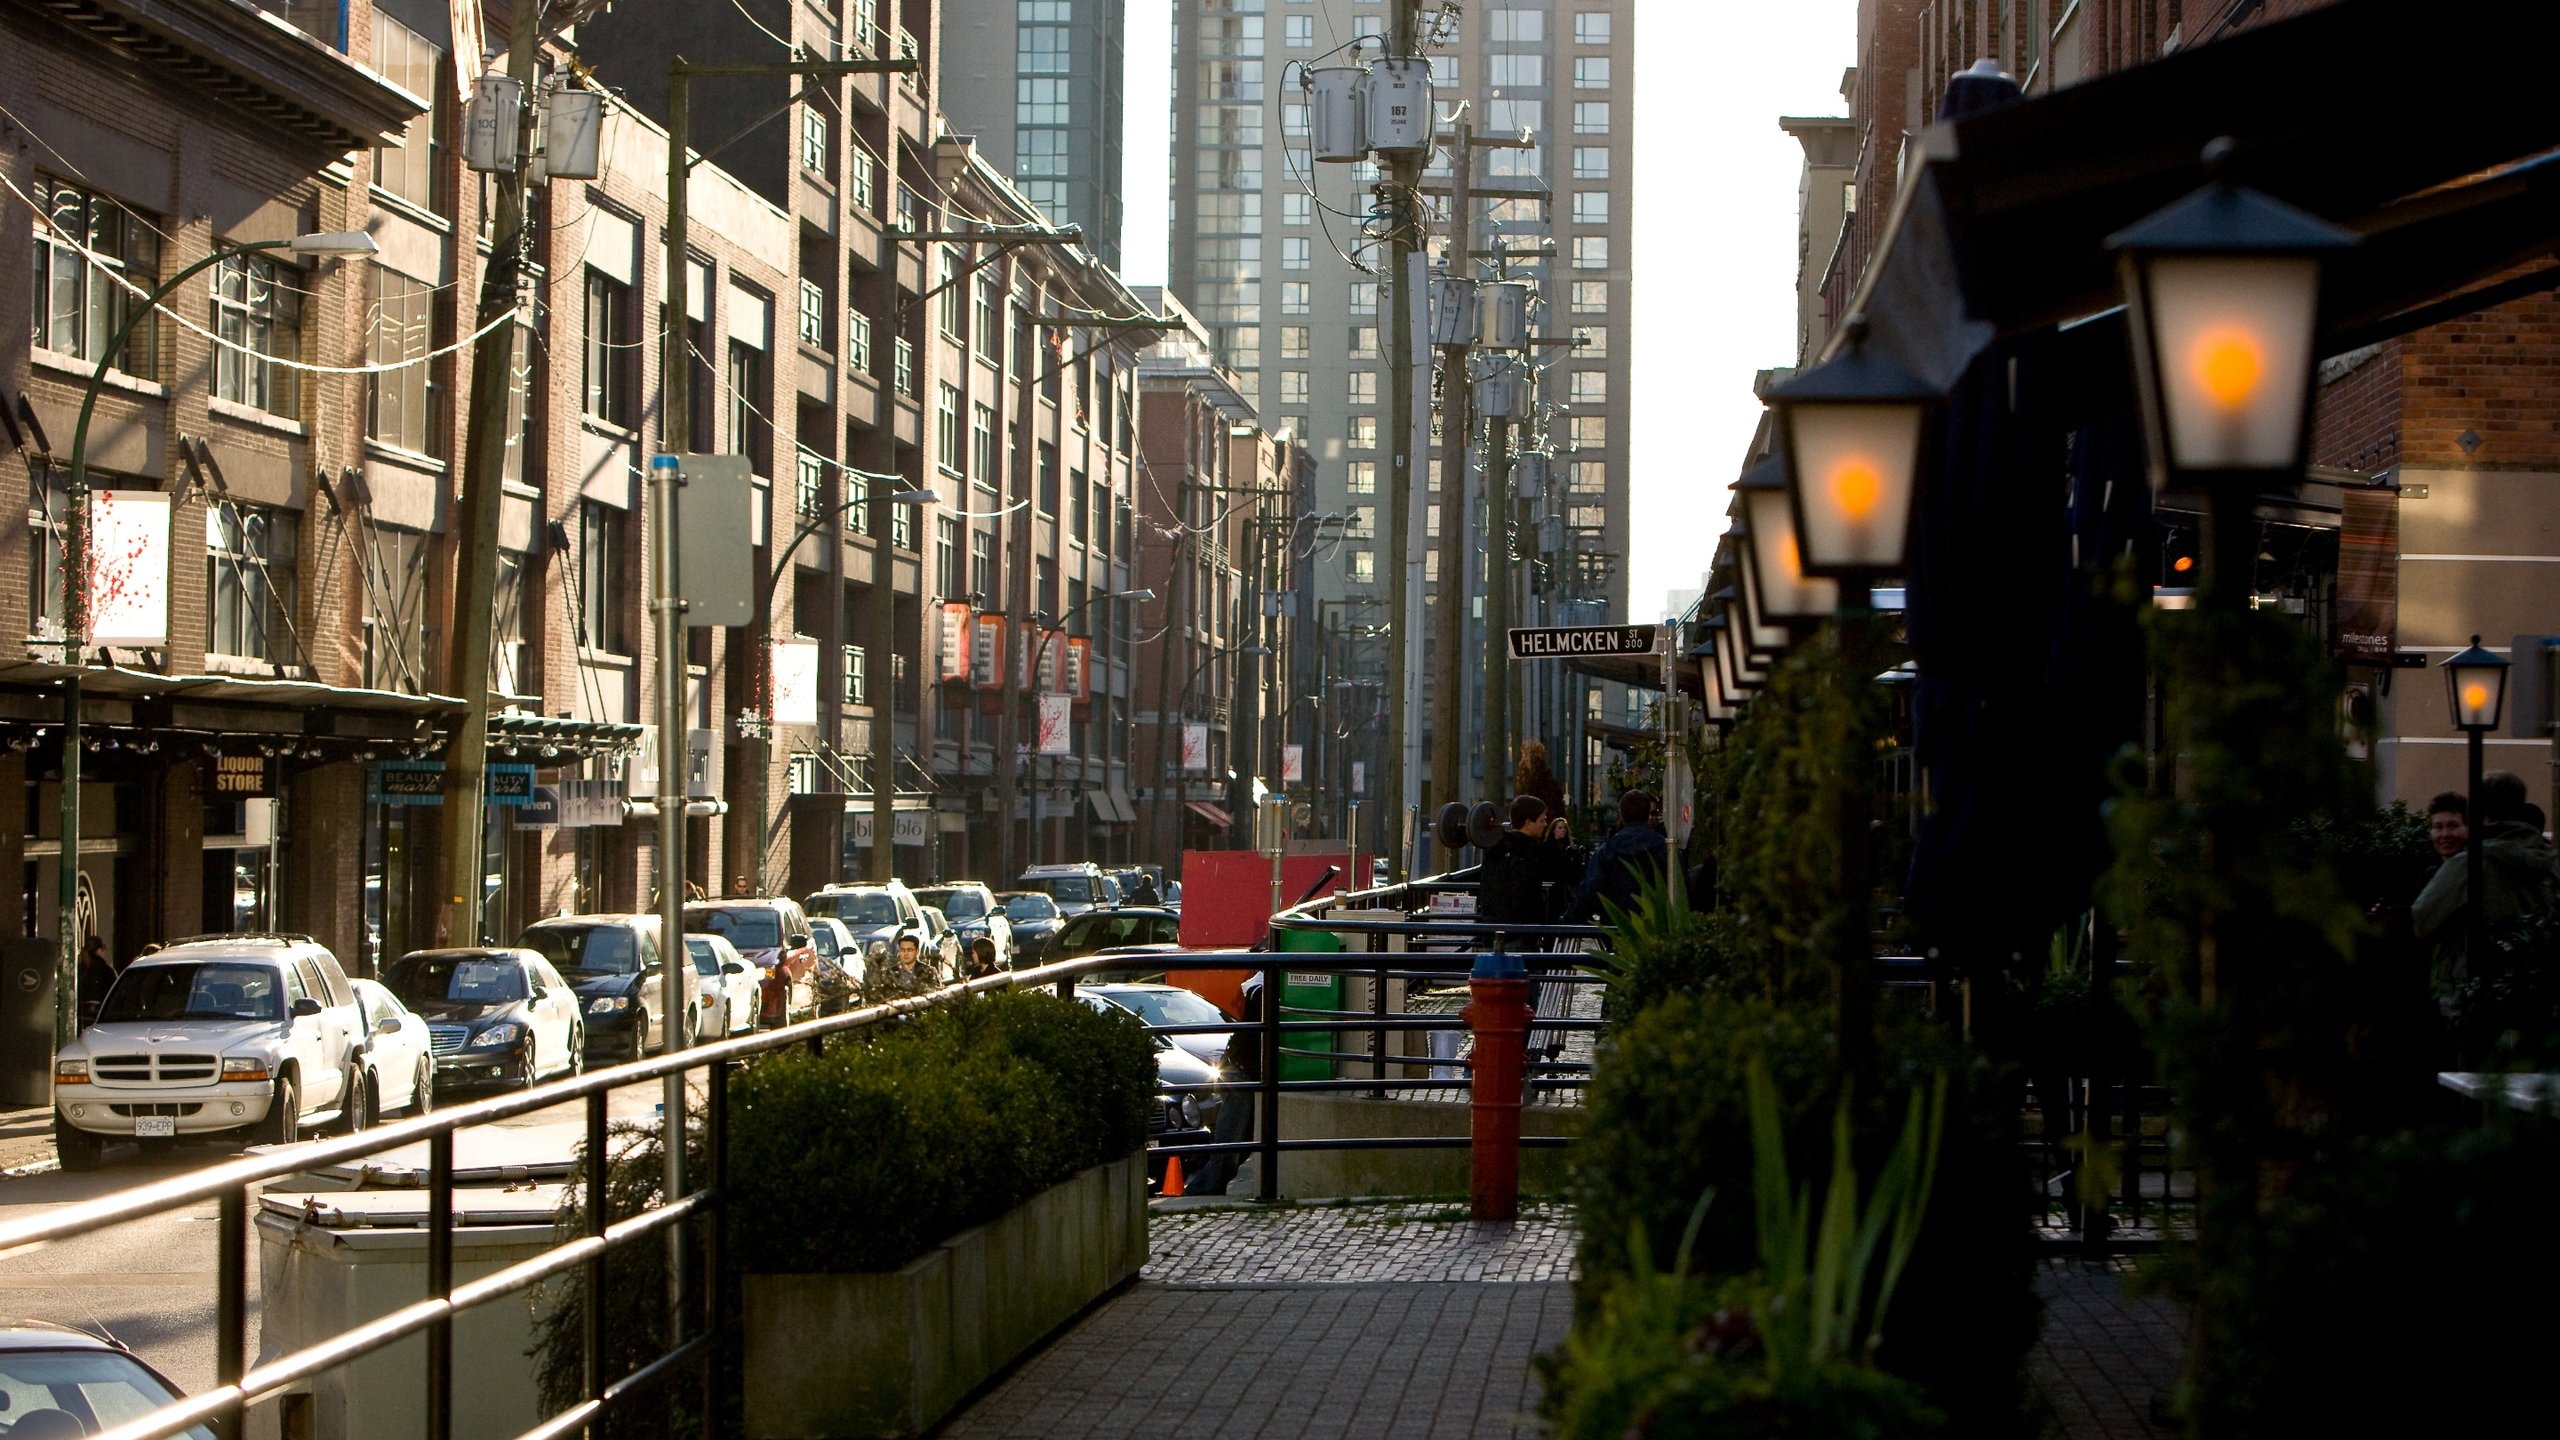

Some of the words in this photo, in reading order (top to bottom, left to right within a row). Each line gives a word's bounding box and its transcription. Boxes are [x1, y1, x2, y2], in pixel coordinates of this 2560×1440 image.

[1391, 105, 1407, 116] 167
[1521, 631, 1618, 653] HELMCKEN
[1628, 629, 1639, 639] ST
[1625, 639, 1643, 649] 300
[2342, 632, 2388, 645] milestones
[217, 756, 264, 773] LIQUOR
[217, 774, 263, 791] STORE
[386, 772, 441, 783] BEAUTY
[388, 779, 437, 792] mark
[1308, 975, 1329, 983] DAILY
